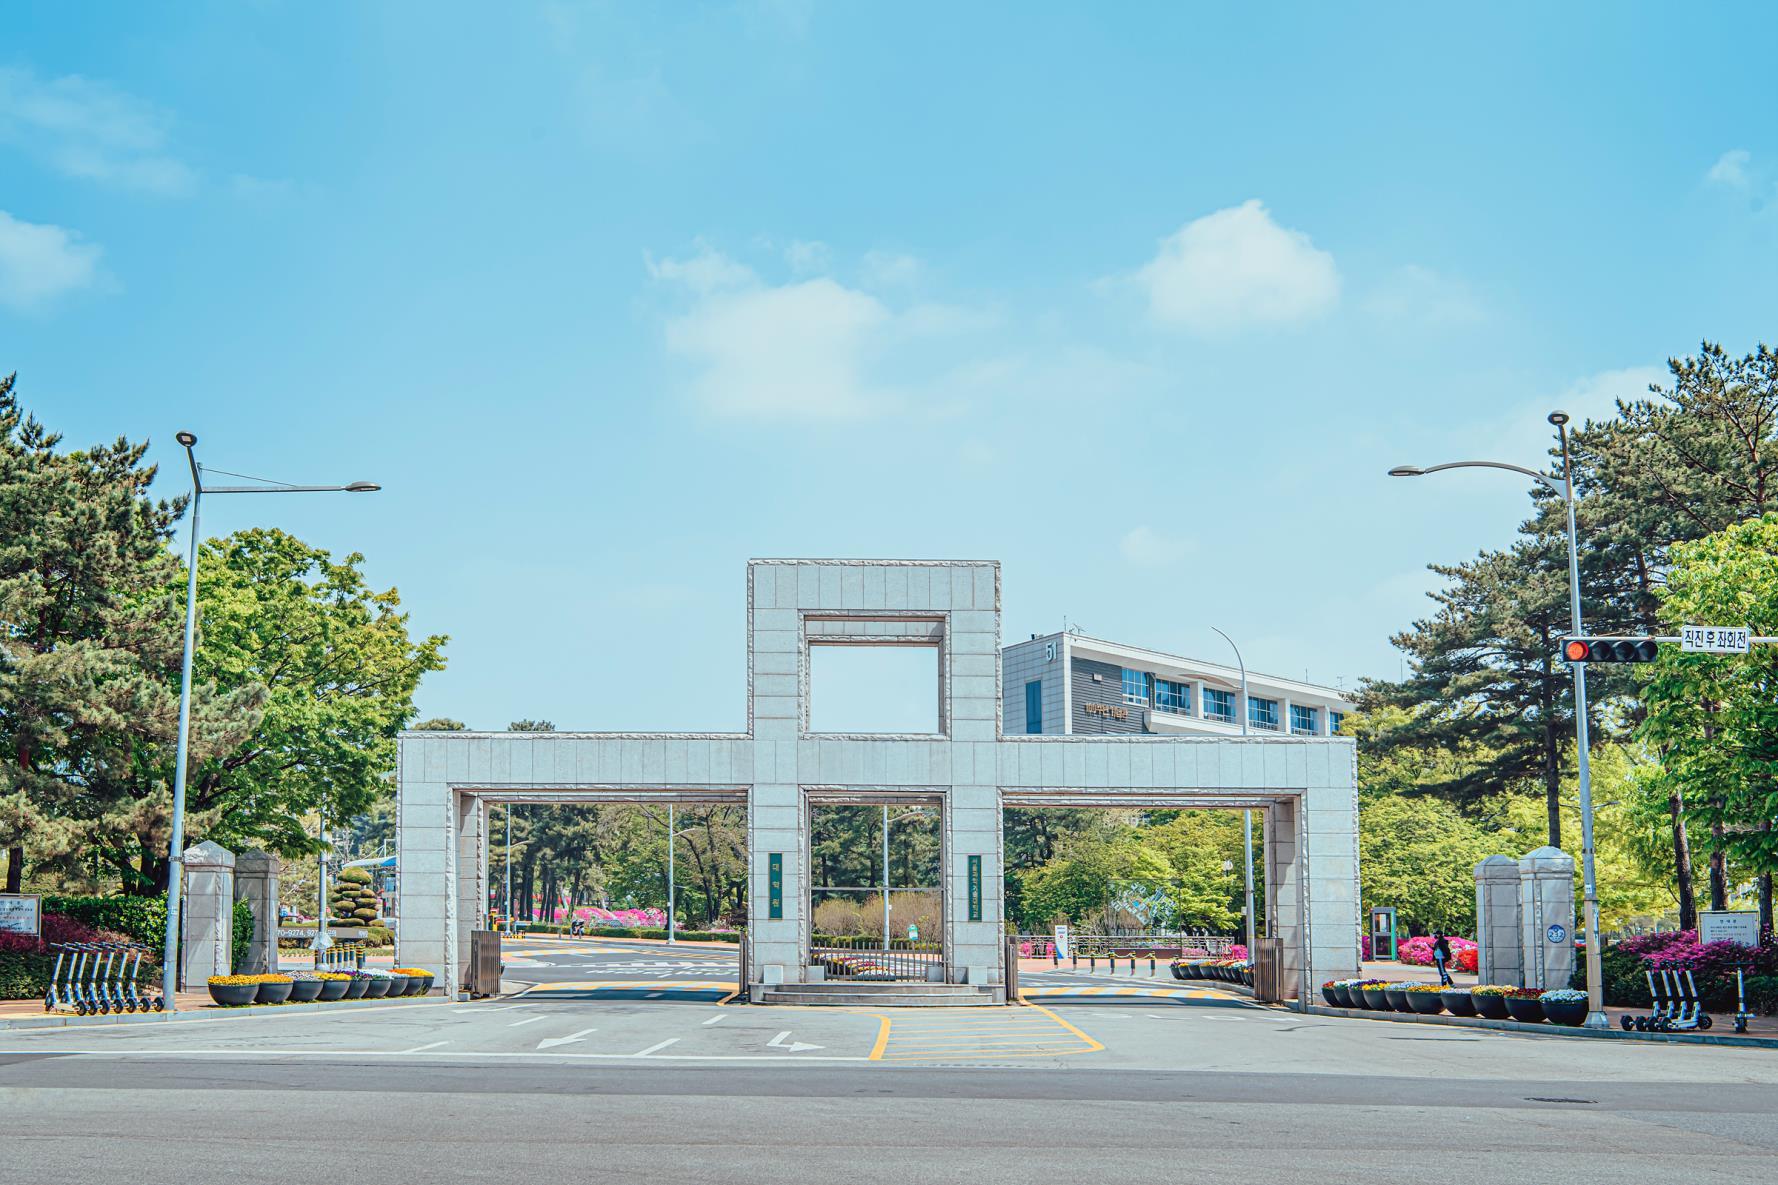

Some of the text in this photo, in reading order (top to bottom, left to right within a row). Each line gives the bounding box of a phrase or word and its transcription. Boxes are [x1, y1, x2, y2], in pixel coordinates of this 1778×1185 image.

[1685, 630, 1746, 649] 직진 후 좌회전
[1046, 641, 1057, 660] 51
